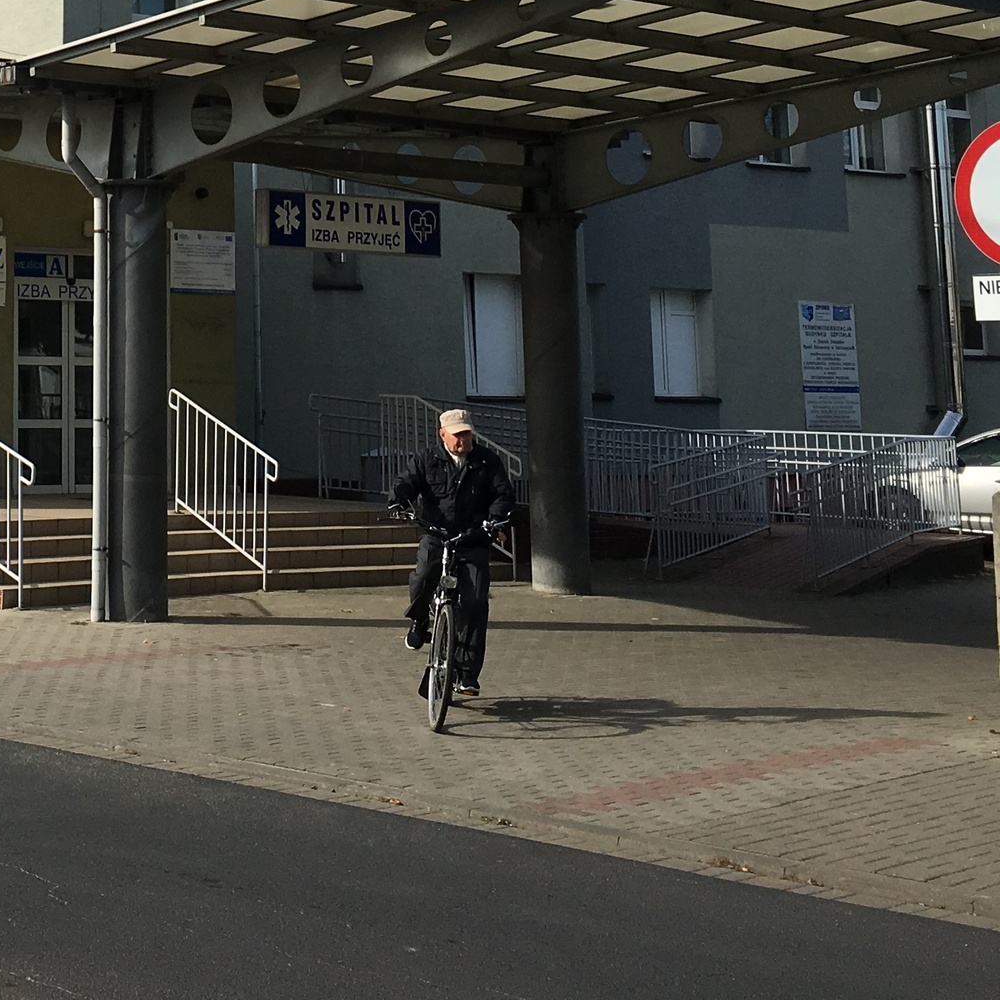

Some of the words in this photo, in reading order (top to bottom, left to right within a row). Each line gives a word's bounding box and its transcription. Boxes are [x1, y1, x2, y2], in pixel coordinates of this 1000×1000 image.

[311, 198, 401, 226] SZPITAL
[311, 228, 340, 243] IZBA
[347, 230, 401, 249] PRZYJĘĆ
[14, 260, 46, 270] WEJŚCIE
[48, 257, 64, 275] A
[17, 283, 51, 298] IZBA
